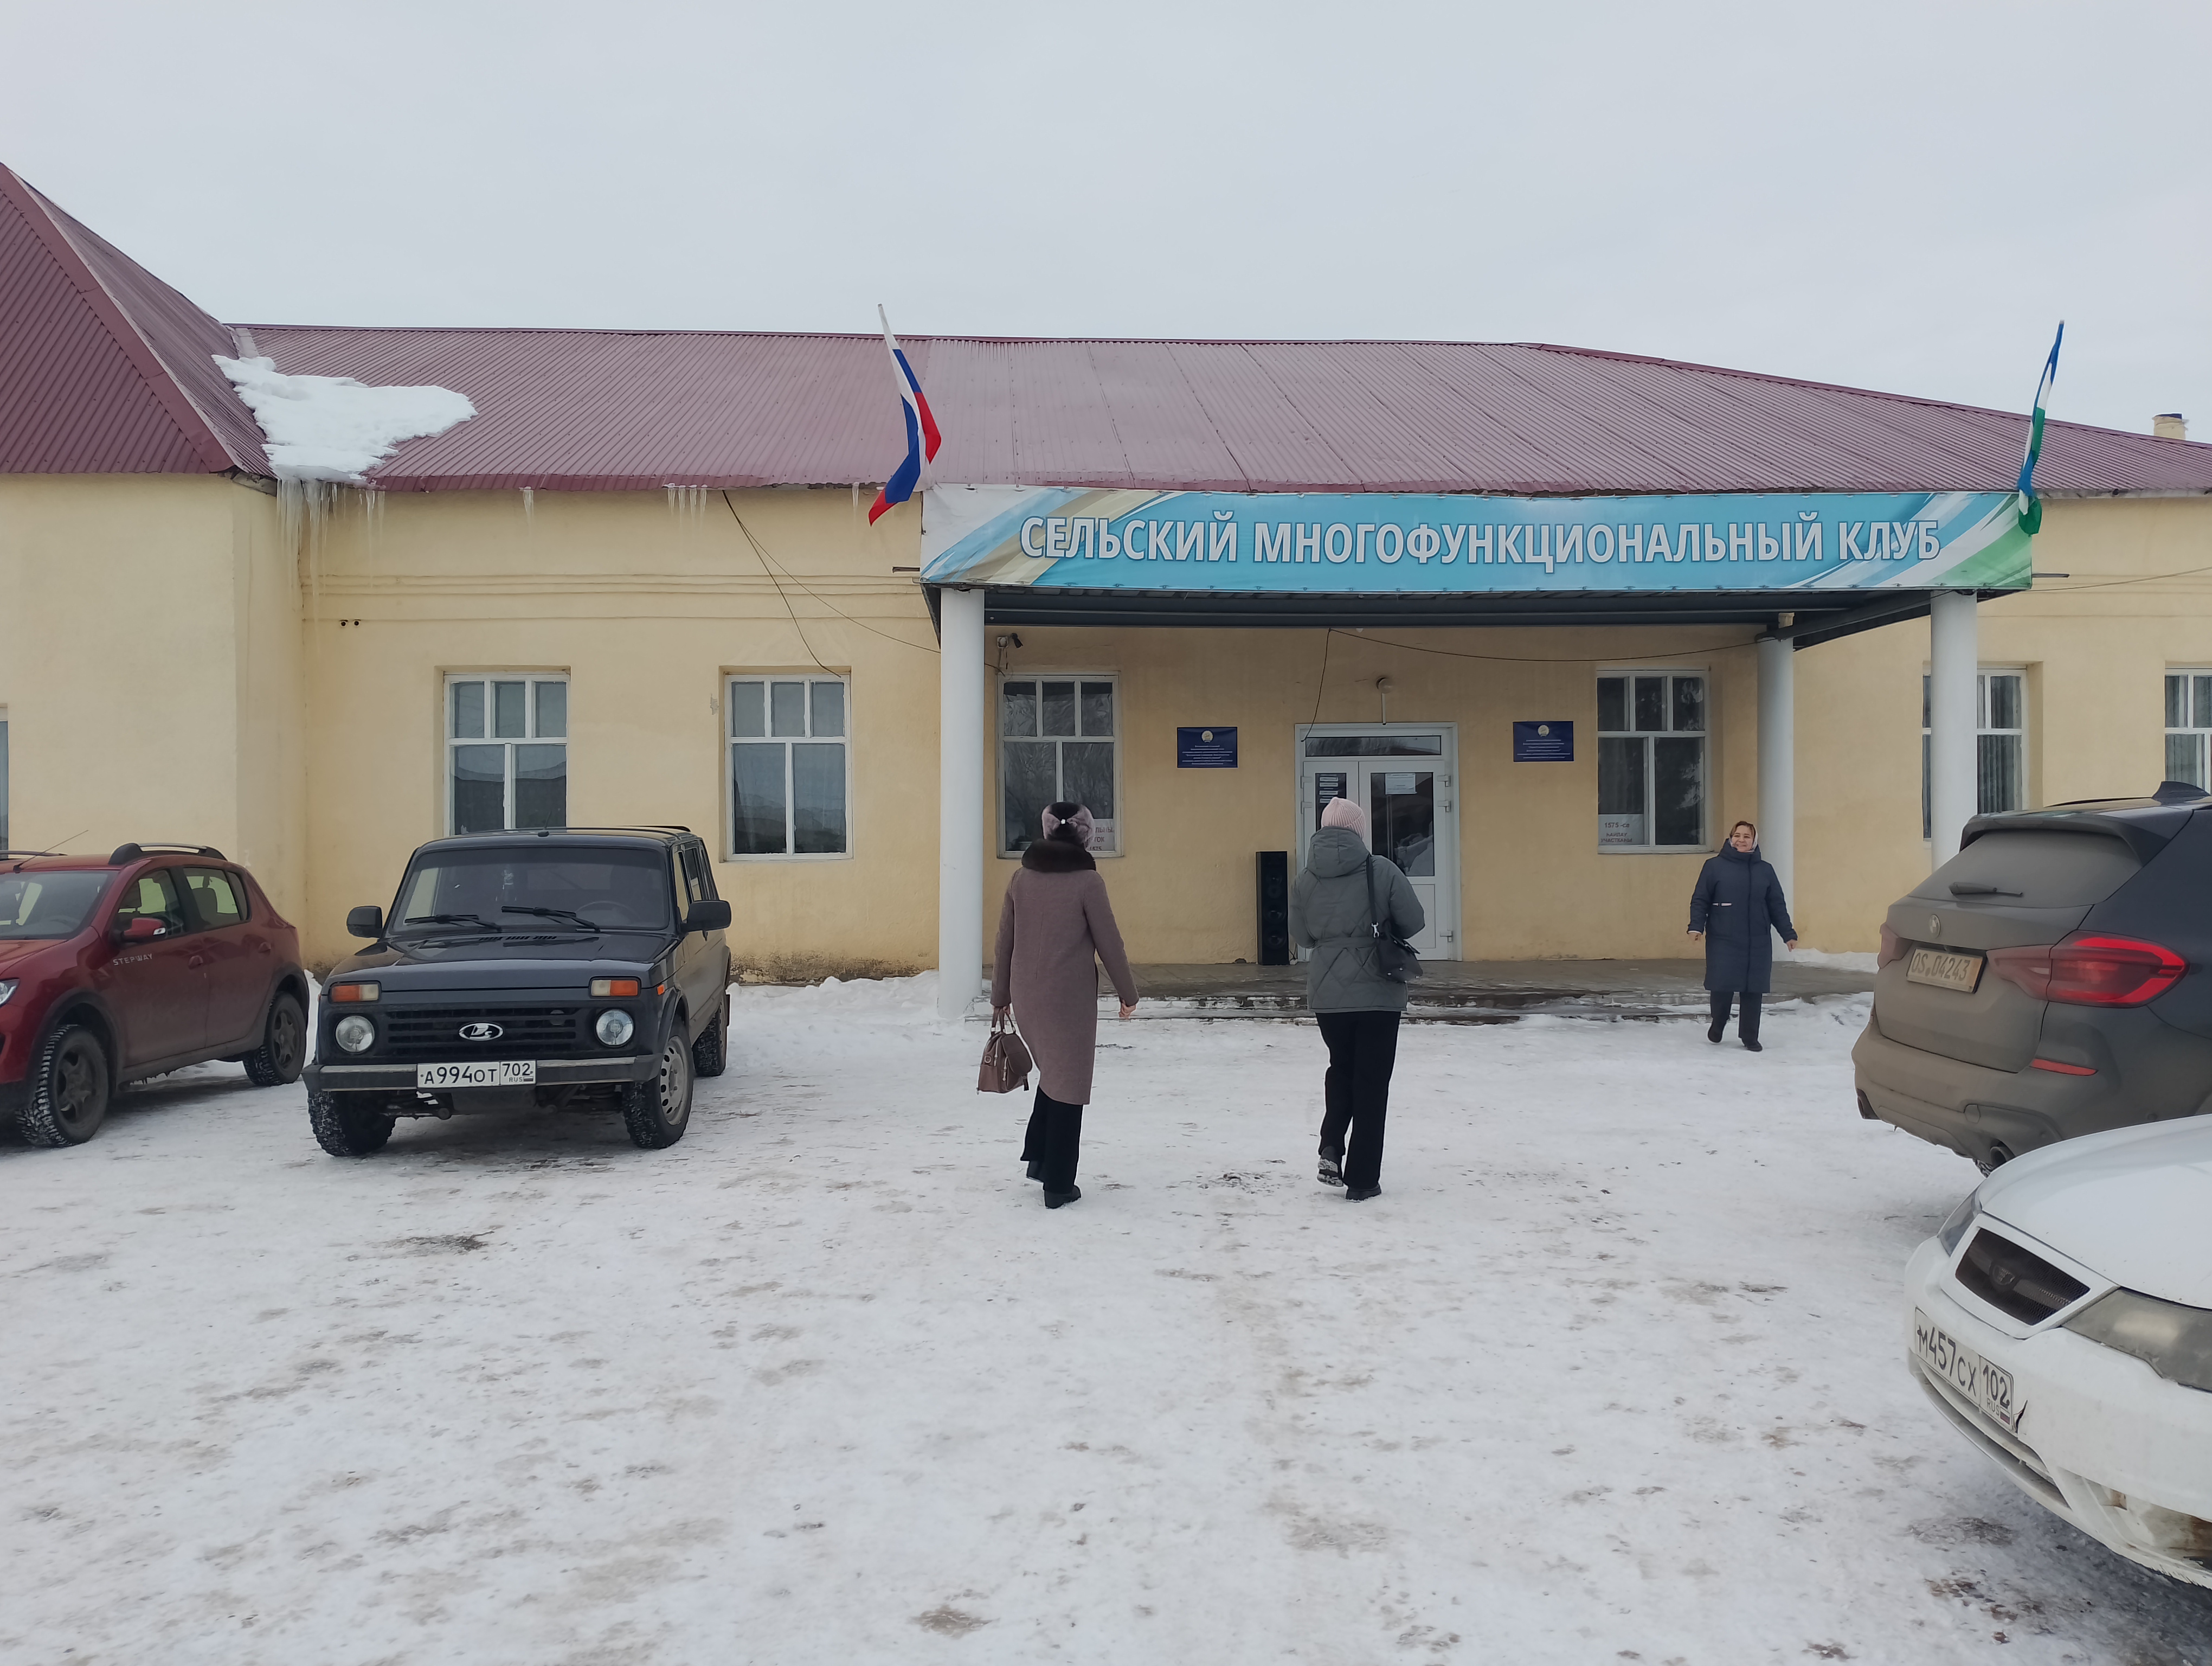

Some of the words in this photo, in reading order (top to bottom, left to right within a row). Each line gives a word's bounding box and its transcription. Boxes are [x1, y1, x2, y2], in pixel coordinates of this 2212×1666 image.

[1019, 510, 1239, 562] СЕЛЬСКИЙ
[1253, 511, 1823, 574] МНОГОФУНКЦИОНАЛЬНЫЙ
[1838, 519, 1941, 561] КЛУБ
[113, 953, 152, 965] STEPWAY
[502, 1063, 531, 1077] 702
[1983, 1364, 2010, 1408] 102
[1987, 1398, 1999, 1417] RUS
